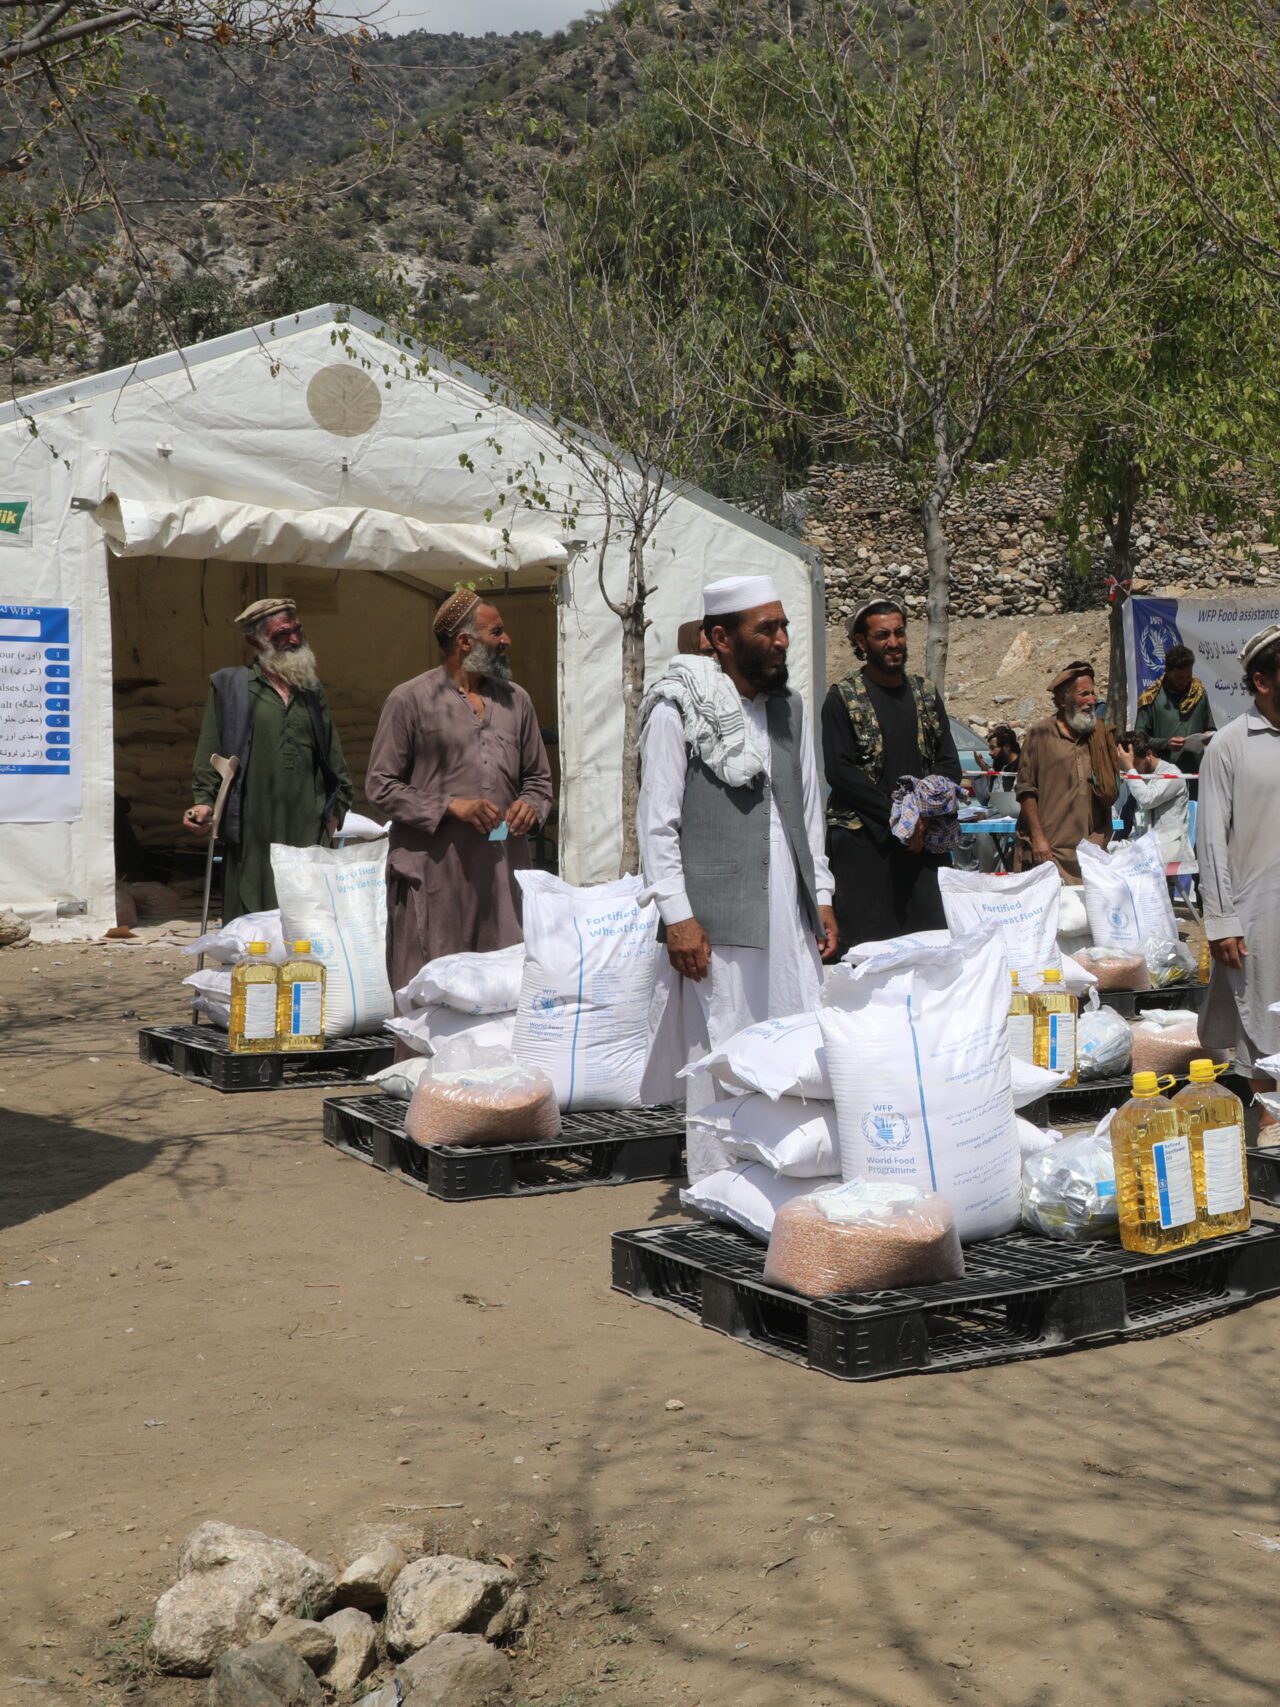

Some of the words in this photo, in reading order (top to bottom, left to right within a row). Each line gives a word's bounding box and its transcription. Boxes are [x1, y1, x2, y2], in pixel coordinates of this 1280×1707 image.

[0, 510, 17, 524] ik
[10, 606, 33, 616] WFP
[1198, 610, 1217, 622] WFP
[1218, 608, 1238, 622] Food
[1239, 607, 1279, 620] assistance
[0, 701, 12, 709] alt
[981, 900, 1022, 912] Fortified
[586, 907, 640, 926] Fortified
[1000, 917, 1020, 925] eat
[1020, 906, 1044, 922] Flour
[866, 1156, 892, 1164] World
[894, 1156, 915, 1164] Food
[868, 1166, 917, 1175] Programme
